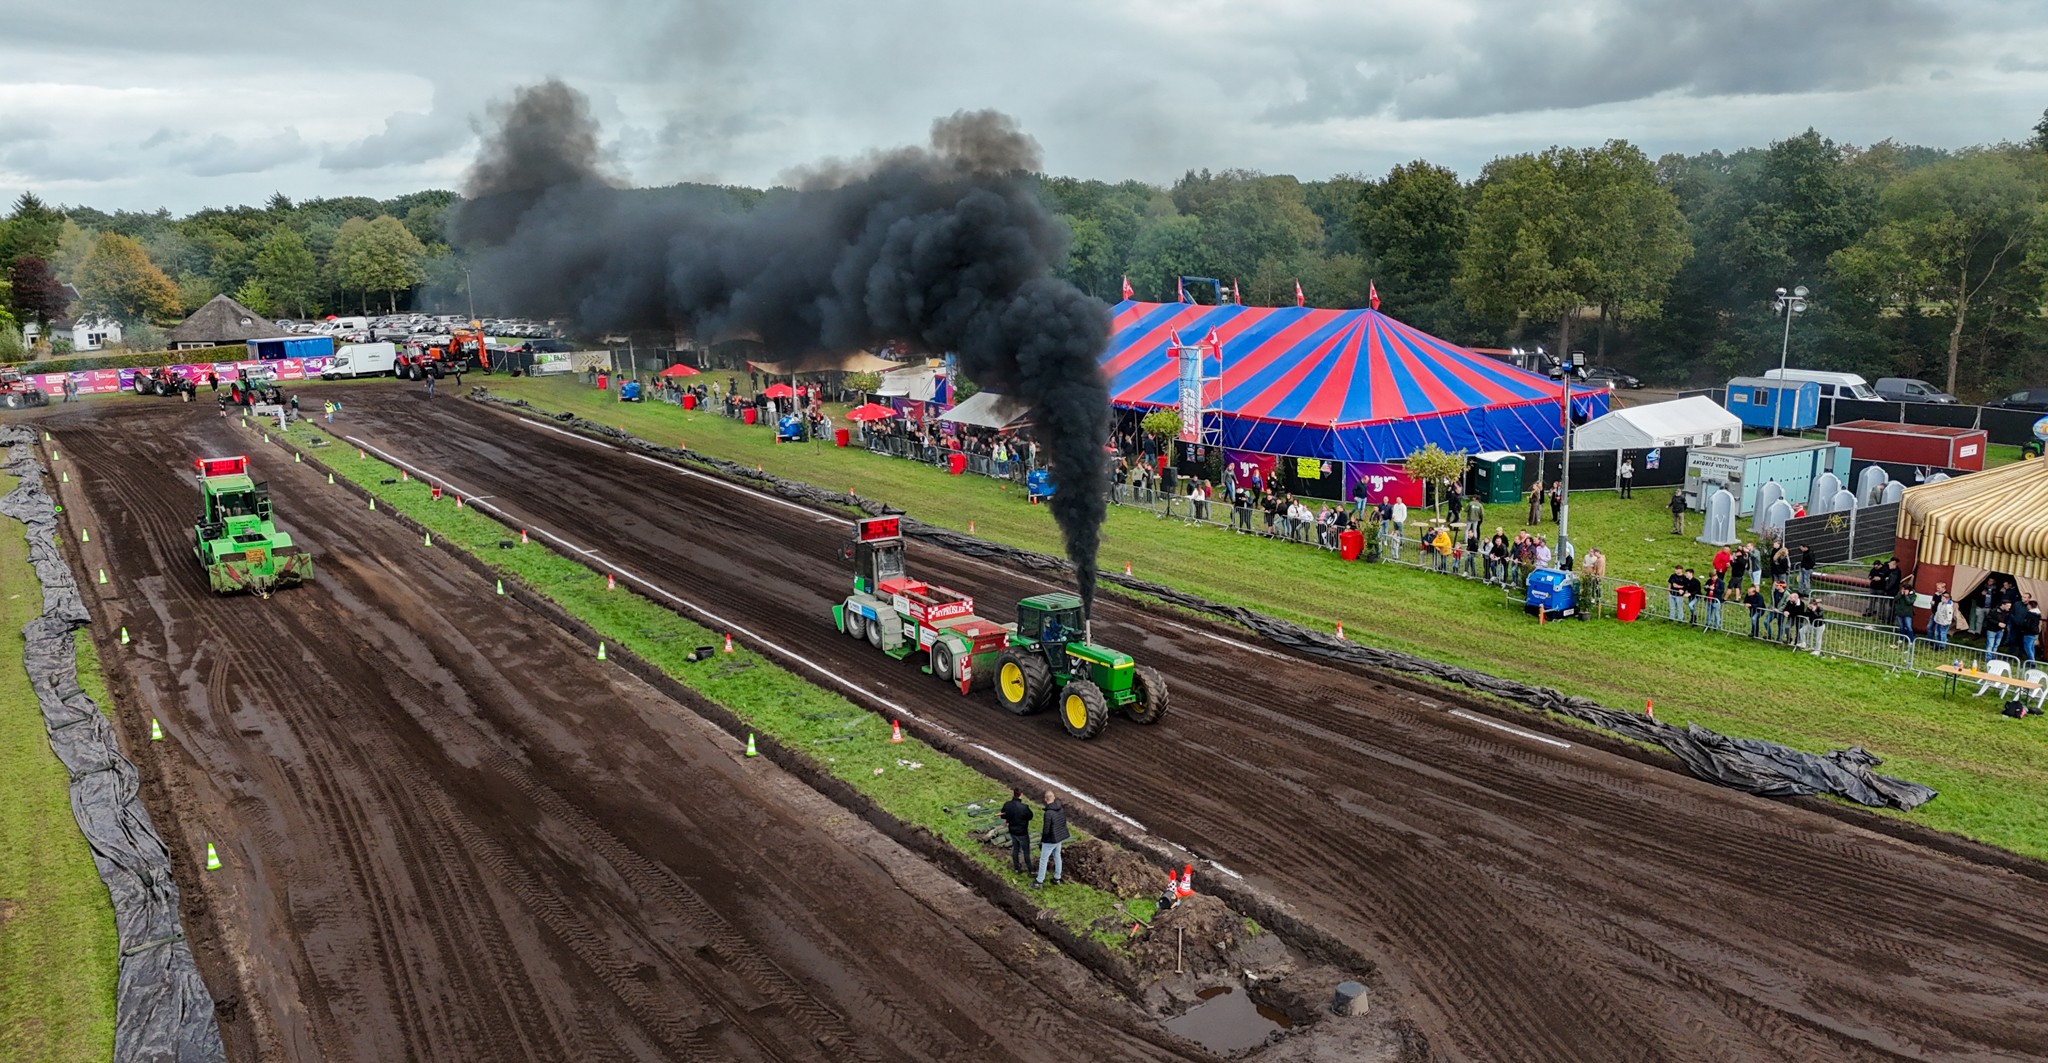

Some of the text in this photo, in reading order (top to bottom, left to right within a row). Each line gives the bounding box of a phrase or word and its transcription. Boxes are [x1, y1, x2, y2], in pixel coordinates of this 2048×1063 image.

[1188, 388, 1196, 435] FEEST
[1703, 455, 1729, 463] TOILETTEN
[867, 518, 897, 532] 9642
